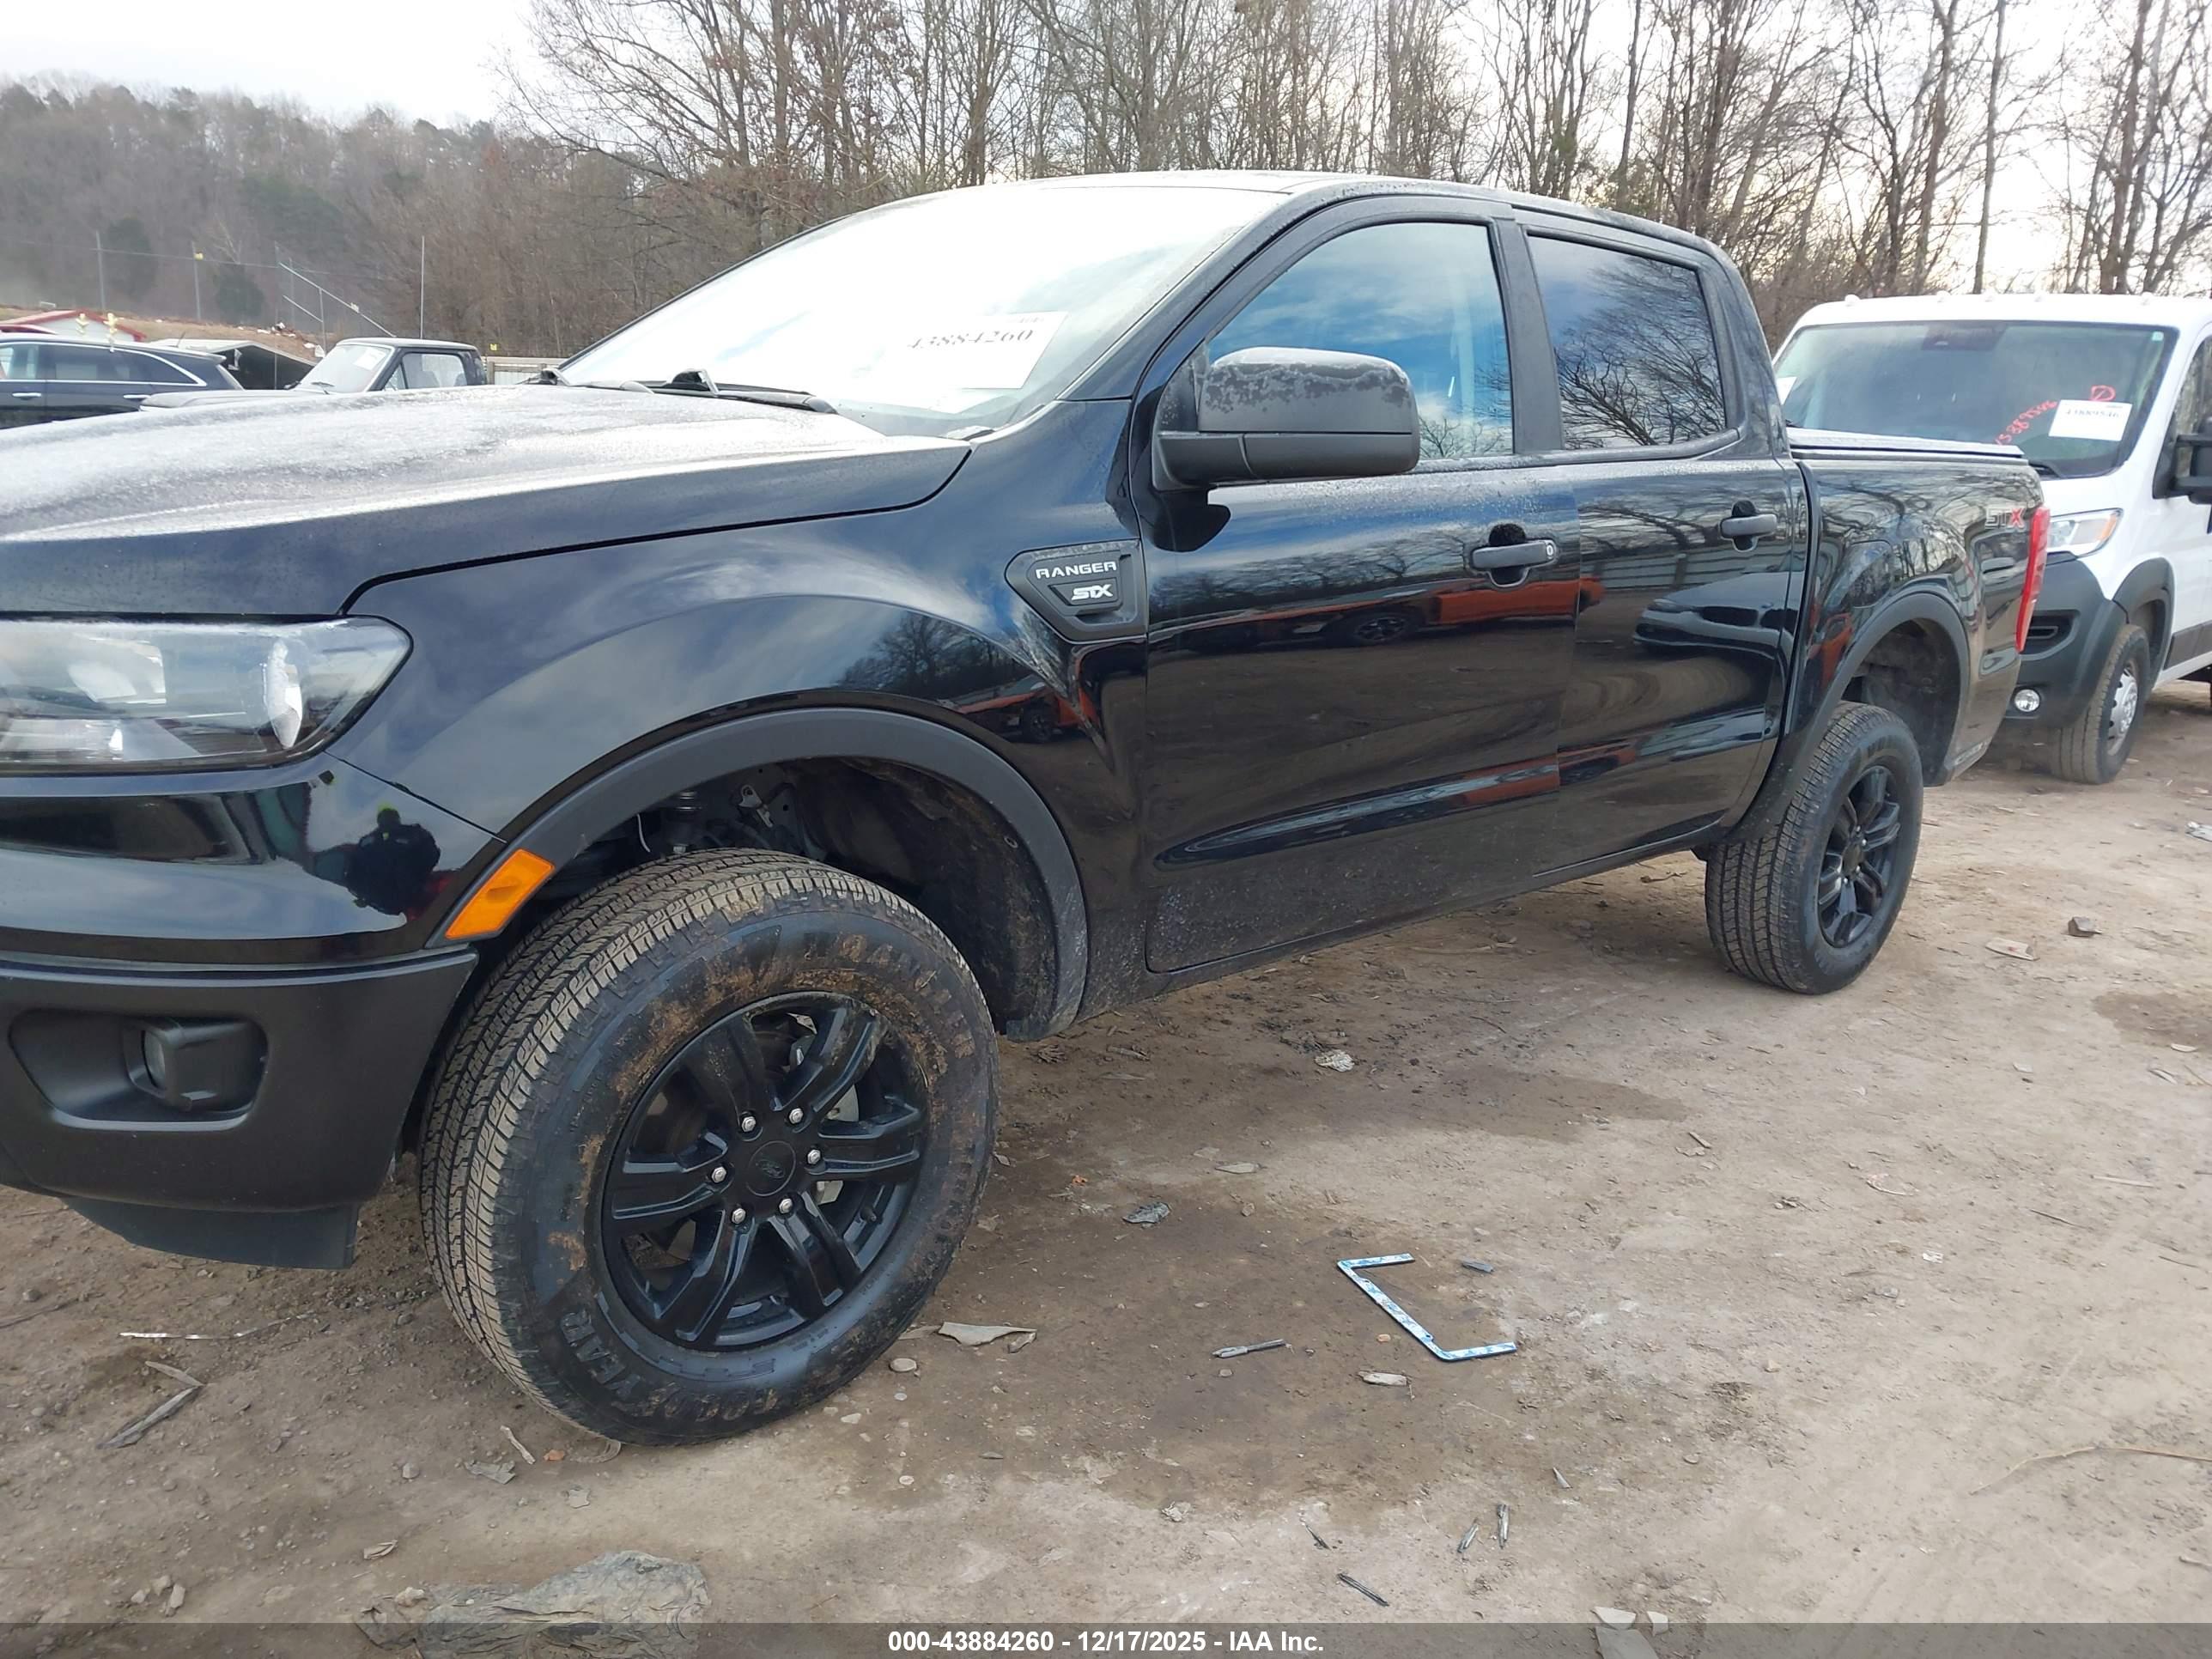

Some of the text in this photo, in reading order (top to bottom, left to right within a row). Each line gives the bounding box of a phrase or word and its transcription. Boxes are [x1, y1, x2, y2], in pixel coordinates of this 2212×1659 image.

[1984, 507, 2026, 530] STX
[1036, 561, 1117, 580] RANGER
[1071, 584, 1114, 601] STX
